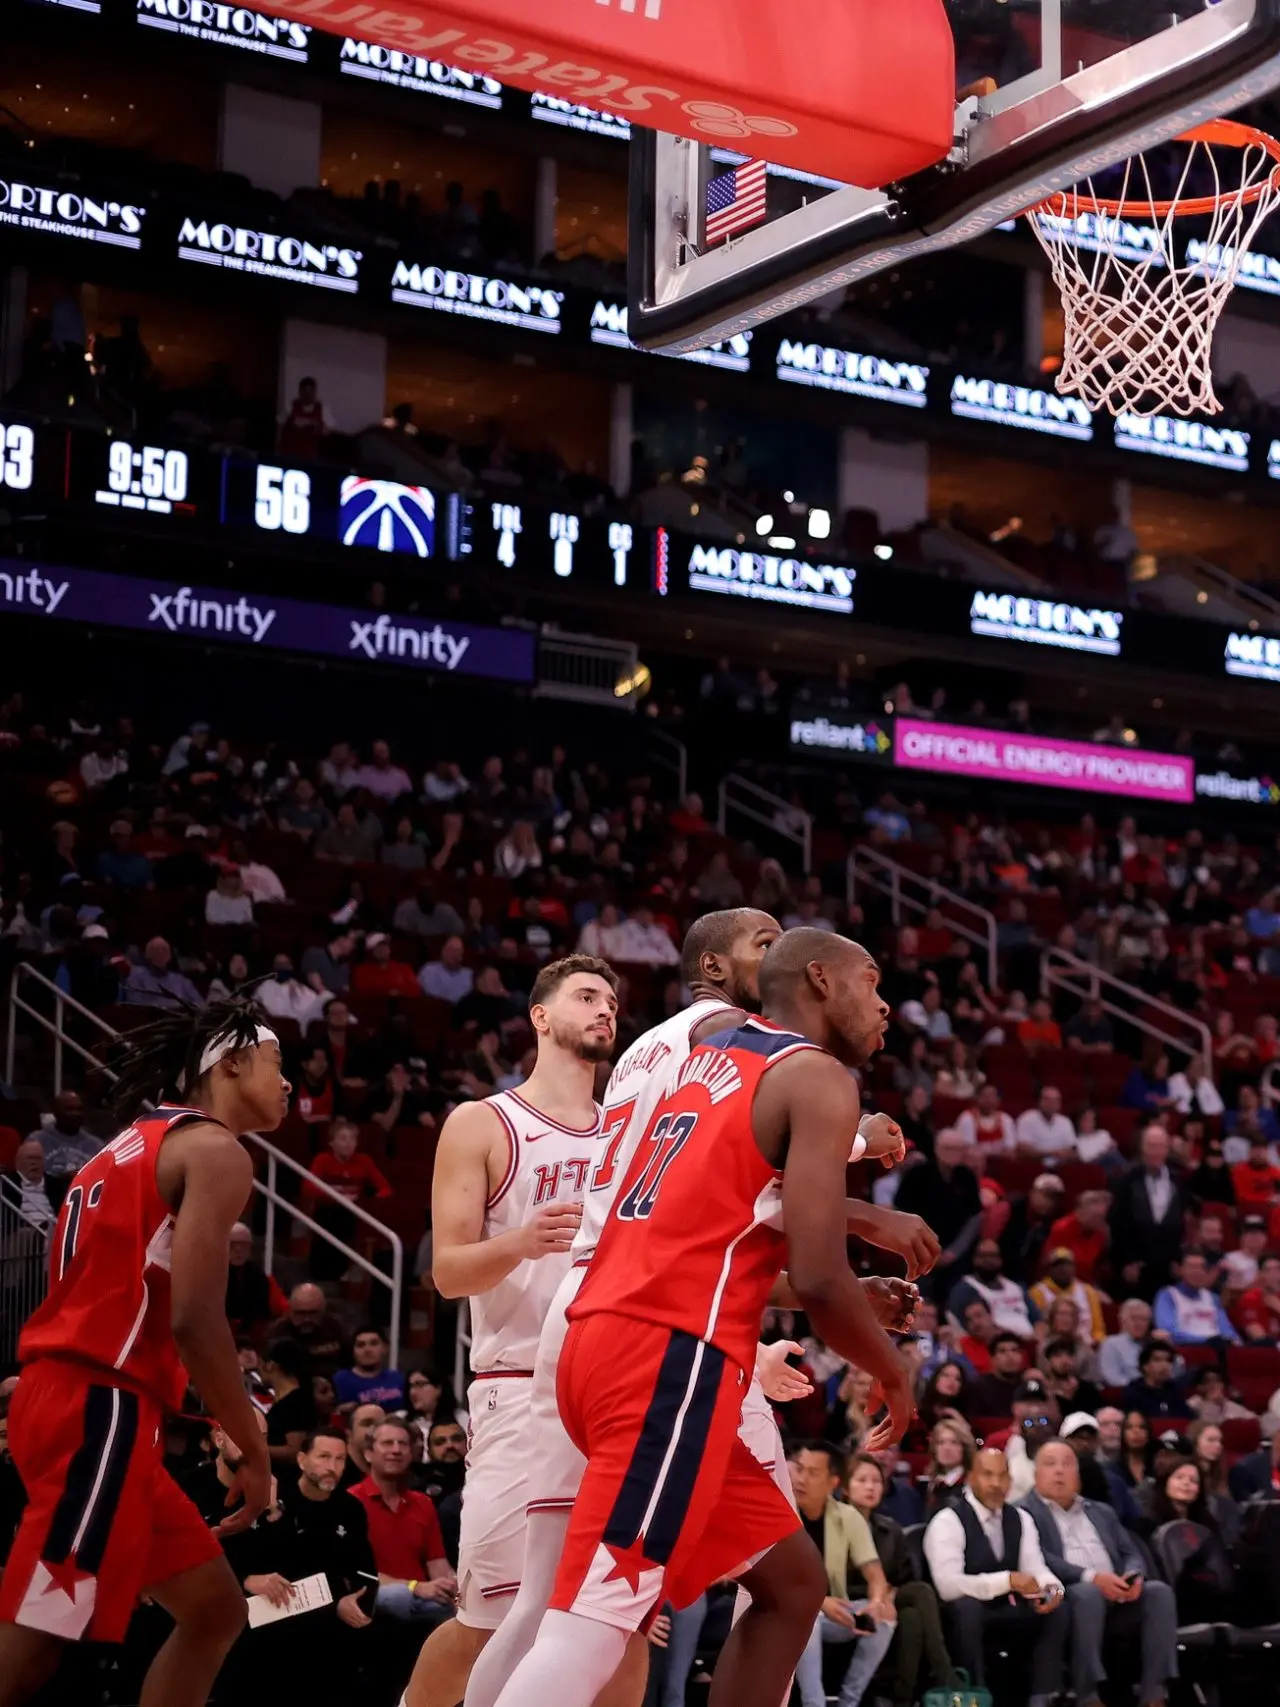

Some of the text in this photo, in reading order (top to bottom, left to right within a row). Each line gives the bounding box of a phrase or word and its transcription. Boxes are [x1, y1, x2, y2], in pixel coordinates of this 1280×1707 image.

[179, 23, 199, 38] THE
[21, 216, 97, 241] STEAKHOUSE
[178, 218, 362, 278] MORTON'S
[858, 250, 898, 276] Hair
[986, 182, 1056, 215] Turkey
[223, 255, 244, 270] THE
[391, 260, 564, 318] MORTON'S
[0, 423, 34, 490] 3
[108, 441, 188, 501] 9:50
[255, 464, 311, 533] 56
[689, 544, 855, 597] MORTON'S
[149, 587, 276, 642] xfinity
[349, 614, 470, 671] xfinity
[791, 719, 864, 753] reliant
[904, 731, 1187, 791] OFFICIAL ENERGY PROVIDER
[1196, 772, 1260, 802] reliant
[609, 1041, 671, 1092] DURANT
[590, 1092, 639, 1192] 7
